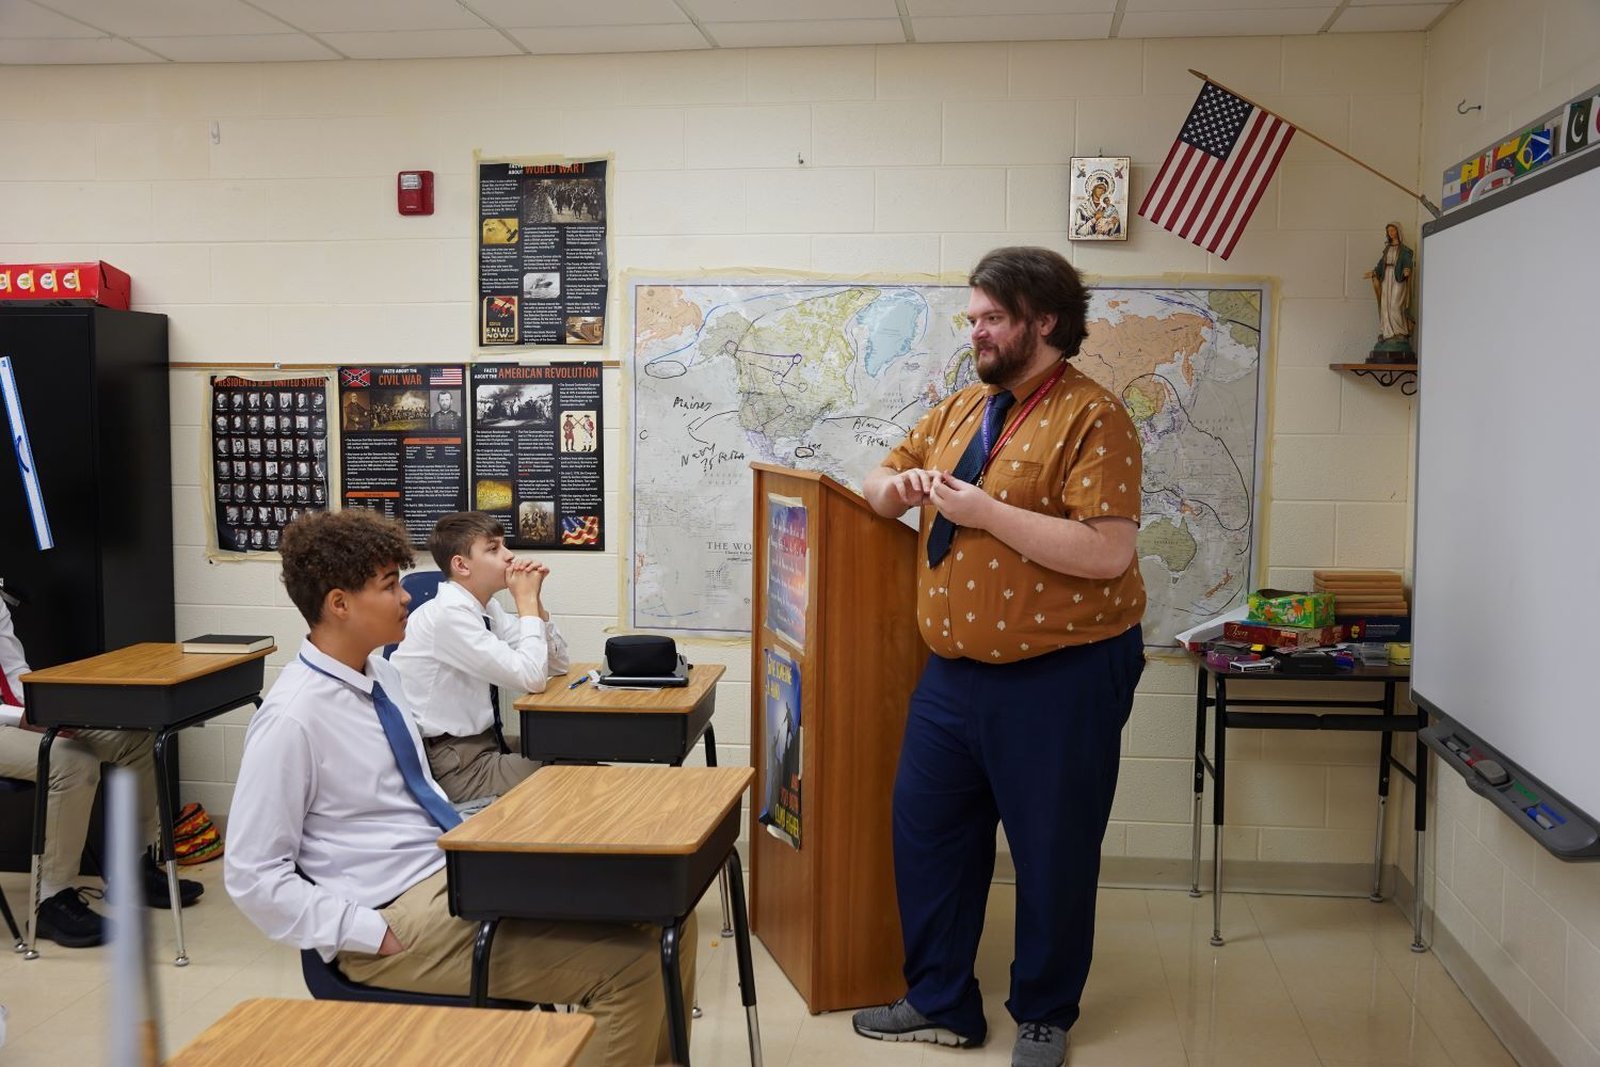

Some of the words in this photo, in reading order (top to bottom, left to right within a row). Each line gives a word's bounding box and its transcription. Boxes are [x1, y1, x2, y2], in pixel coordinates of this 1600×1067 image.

[525, 164, 556, 175] WORLD
[559, 163, 580, 174] WAR
[498, 367, 543, 379] AMERICAN
[544, 367, 599, 379] REVOLUTION
[273, 378, 300, 387] UNITED
[378, 374, 400, 386] CIVIL
[402, 374, 422, 385] WAR
[707, 541, 729, 550] THE
